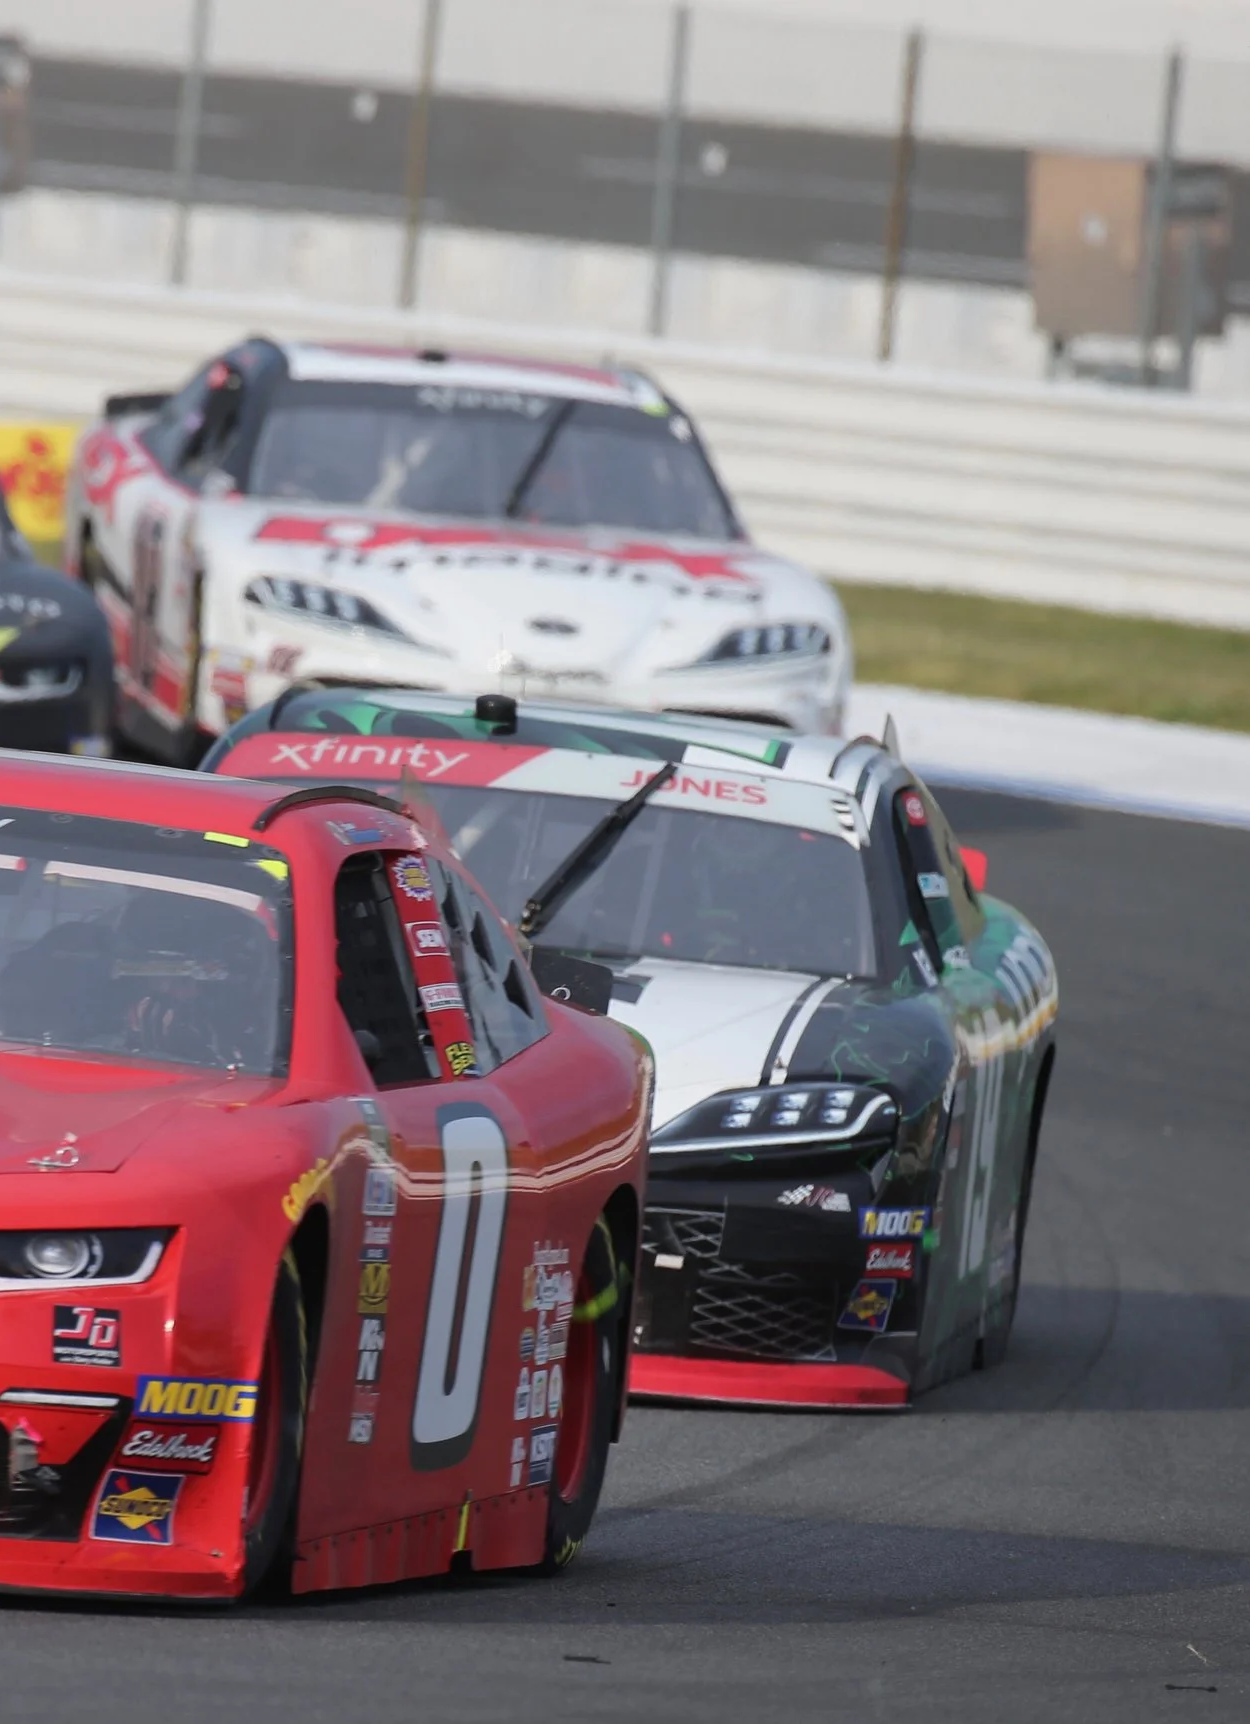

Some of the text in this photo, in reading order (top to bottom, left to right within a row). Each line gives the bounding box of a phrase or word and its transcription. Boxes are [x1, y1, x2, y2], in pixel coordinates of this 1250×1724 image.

[269, 736, 471, 778] xfinity
[619, 769, 768, 806] JONES
[861, 1210, 927, 1237] MOOG
[412, 1112, 510, 1450] 0
[139, 1380, 259, 1419] MOOG
[121, 1429, 217, 1463] Edelbrock
